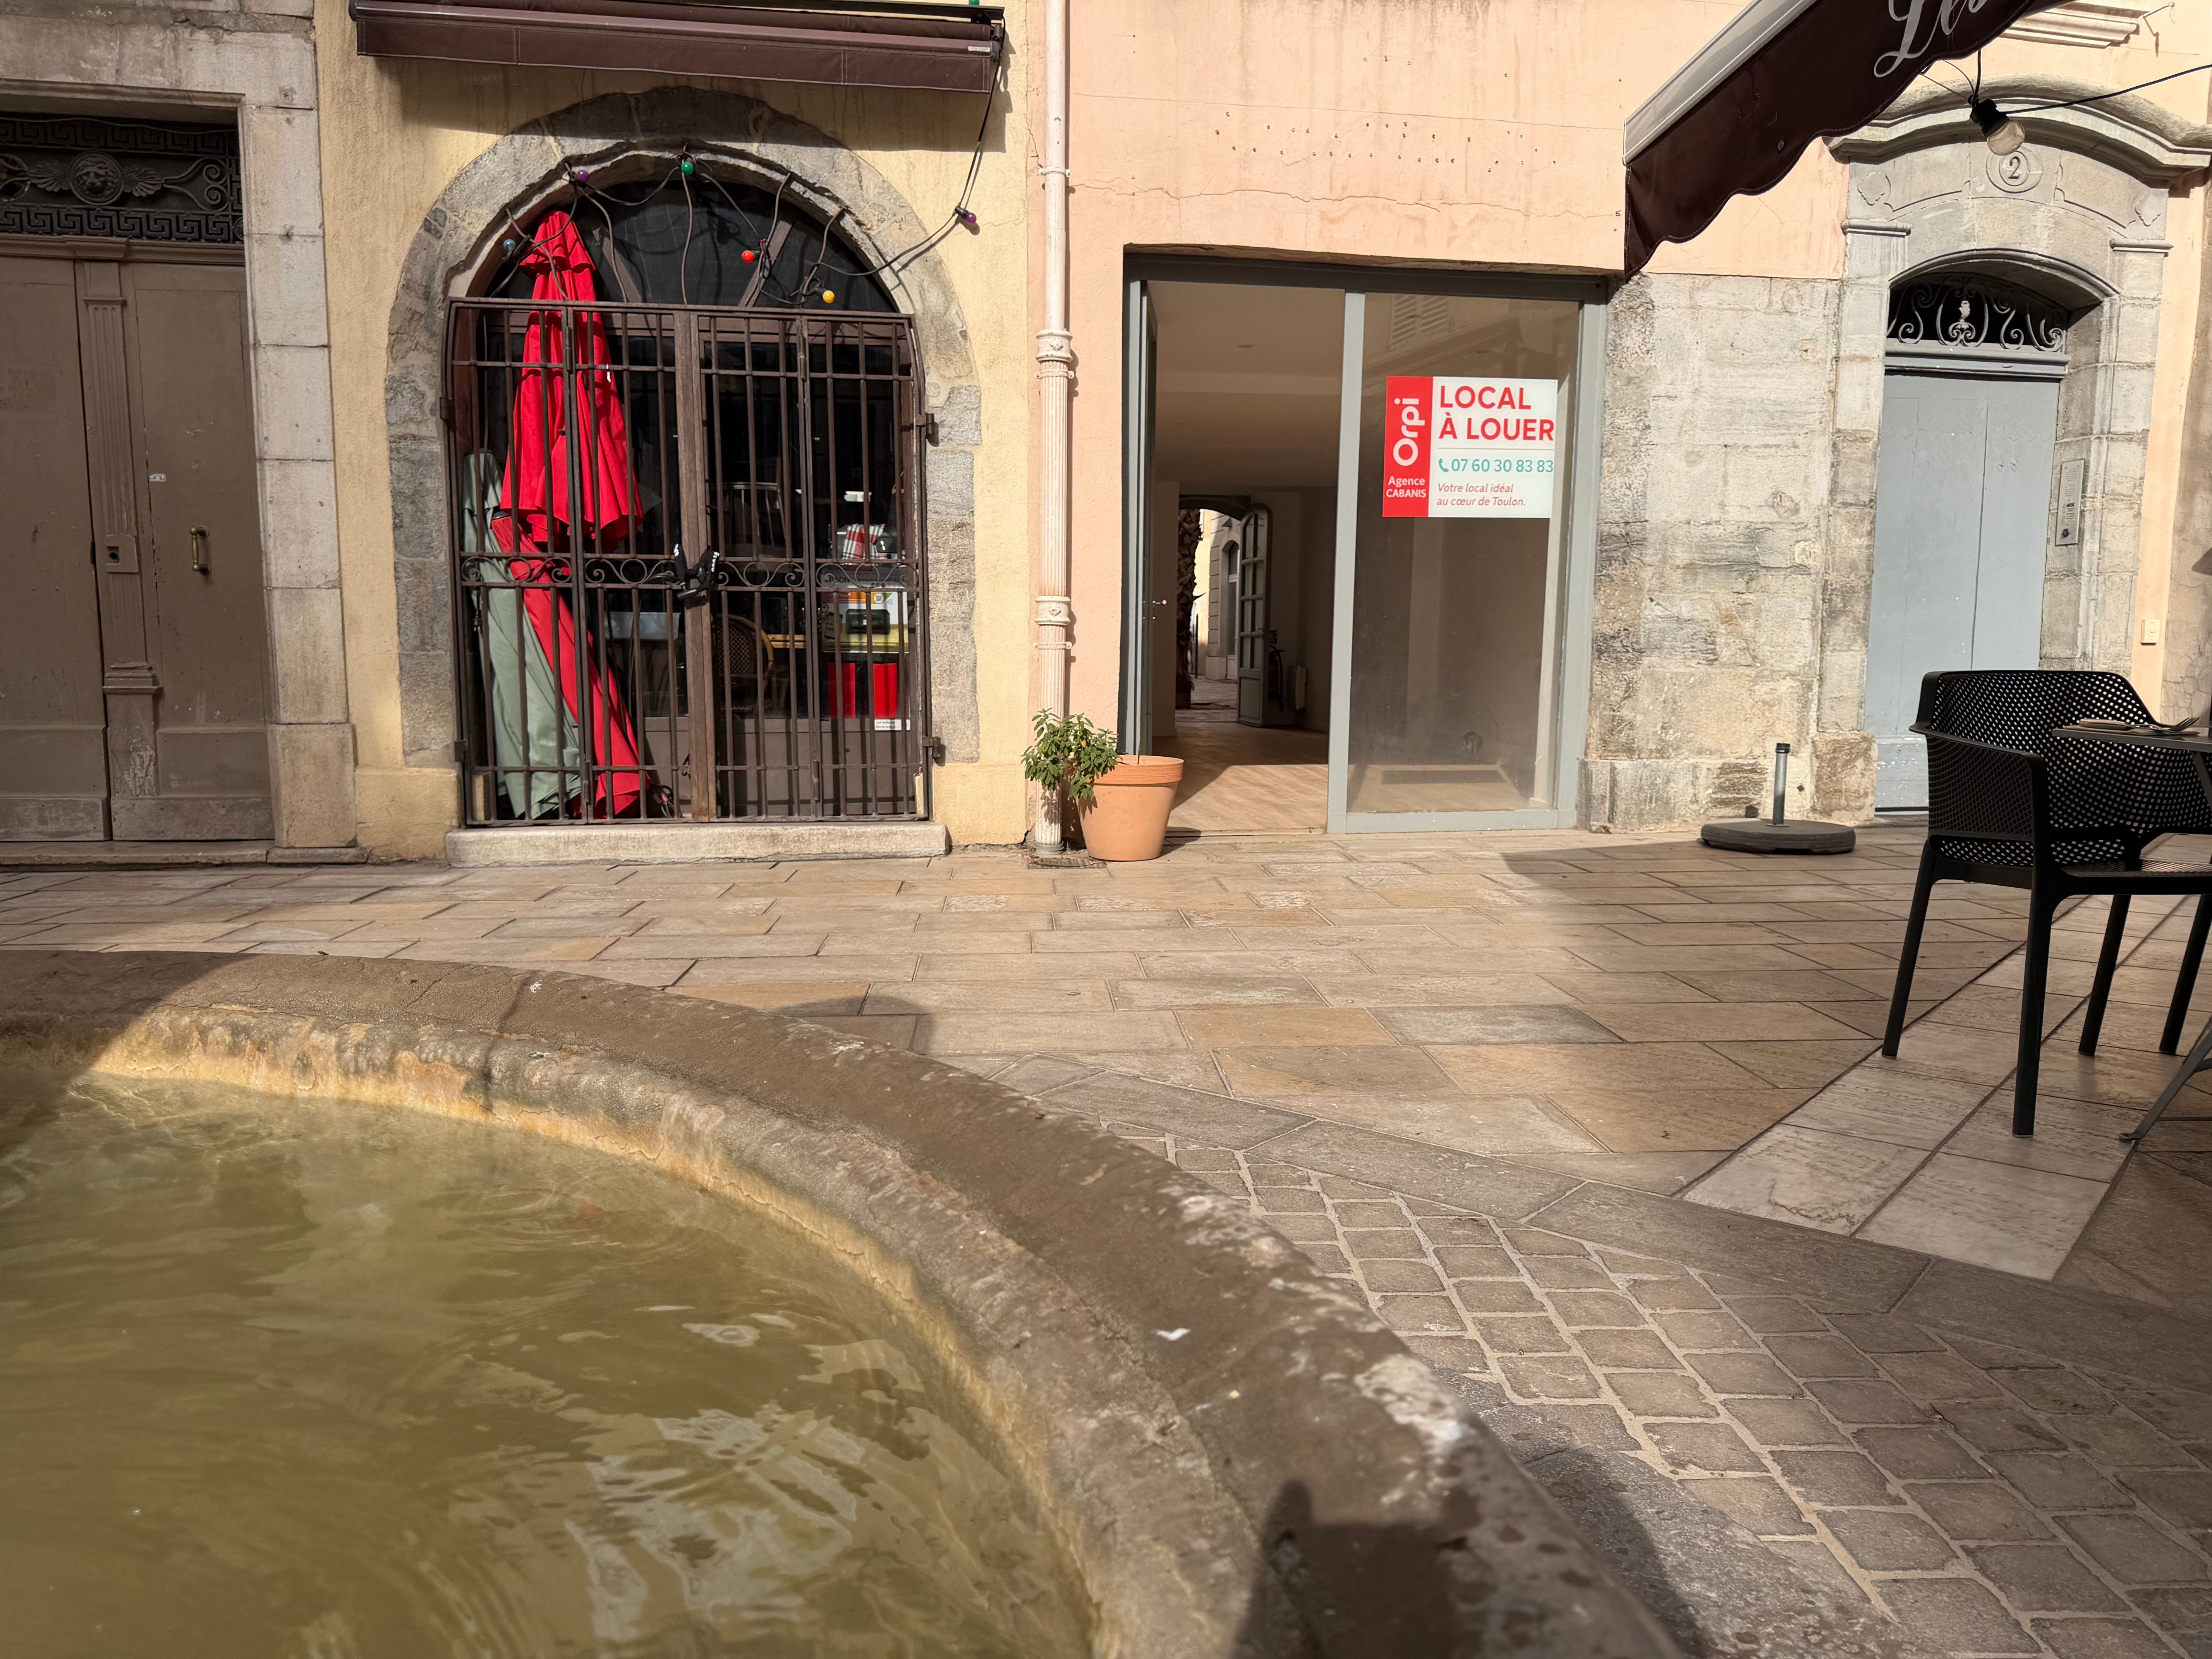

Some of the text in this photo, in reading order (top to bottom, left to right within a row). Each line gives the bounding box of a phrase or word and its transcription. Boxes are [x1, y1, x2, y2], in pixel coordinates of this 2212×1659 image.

[2008, 156, 2021, 179] 2
[1440, 386, 1531, 410] LOCAL
[1393, 398, 1425, 466] Orpi
[1439, 412, 1554, 441] À LOUER
[1451, 459, 1554, 473] 07 60 30 83 83
[1388, 476, 1425, 487] Agence
[1437, 483, 1514, 493] Votre local idéal
[1386, 488, 1427, 498] CABANIS
[1478, 496, 1490, 506] de
[1492, 496, 1526, 506] Toulon.
